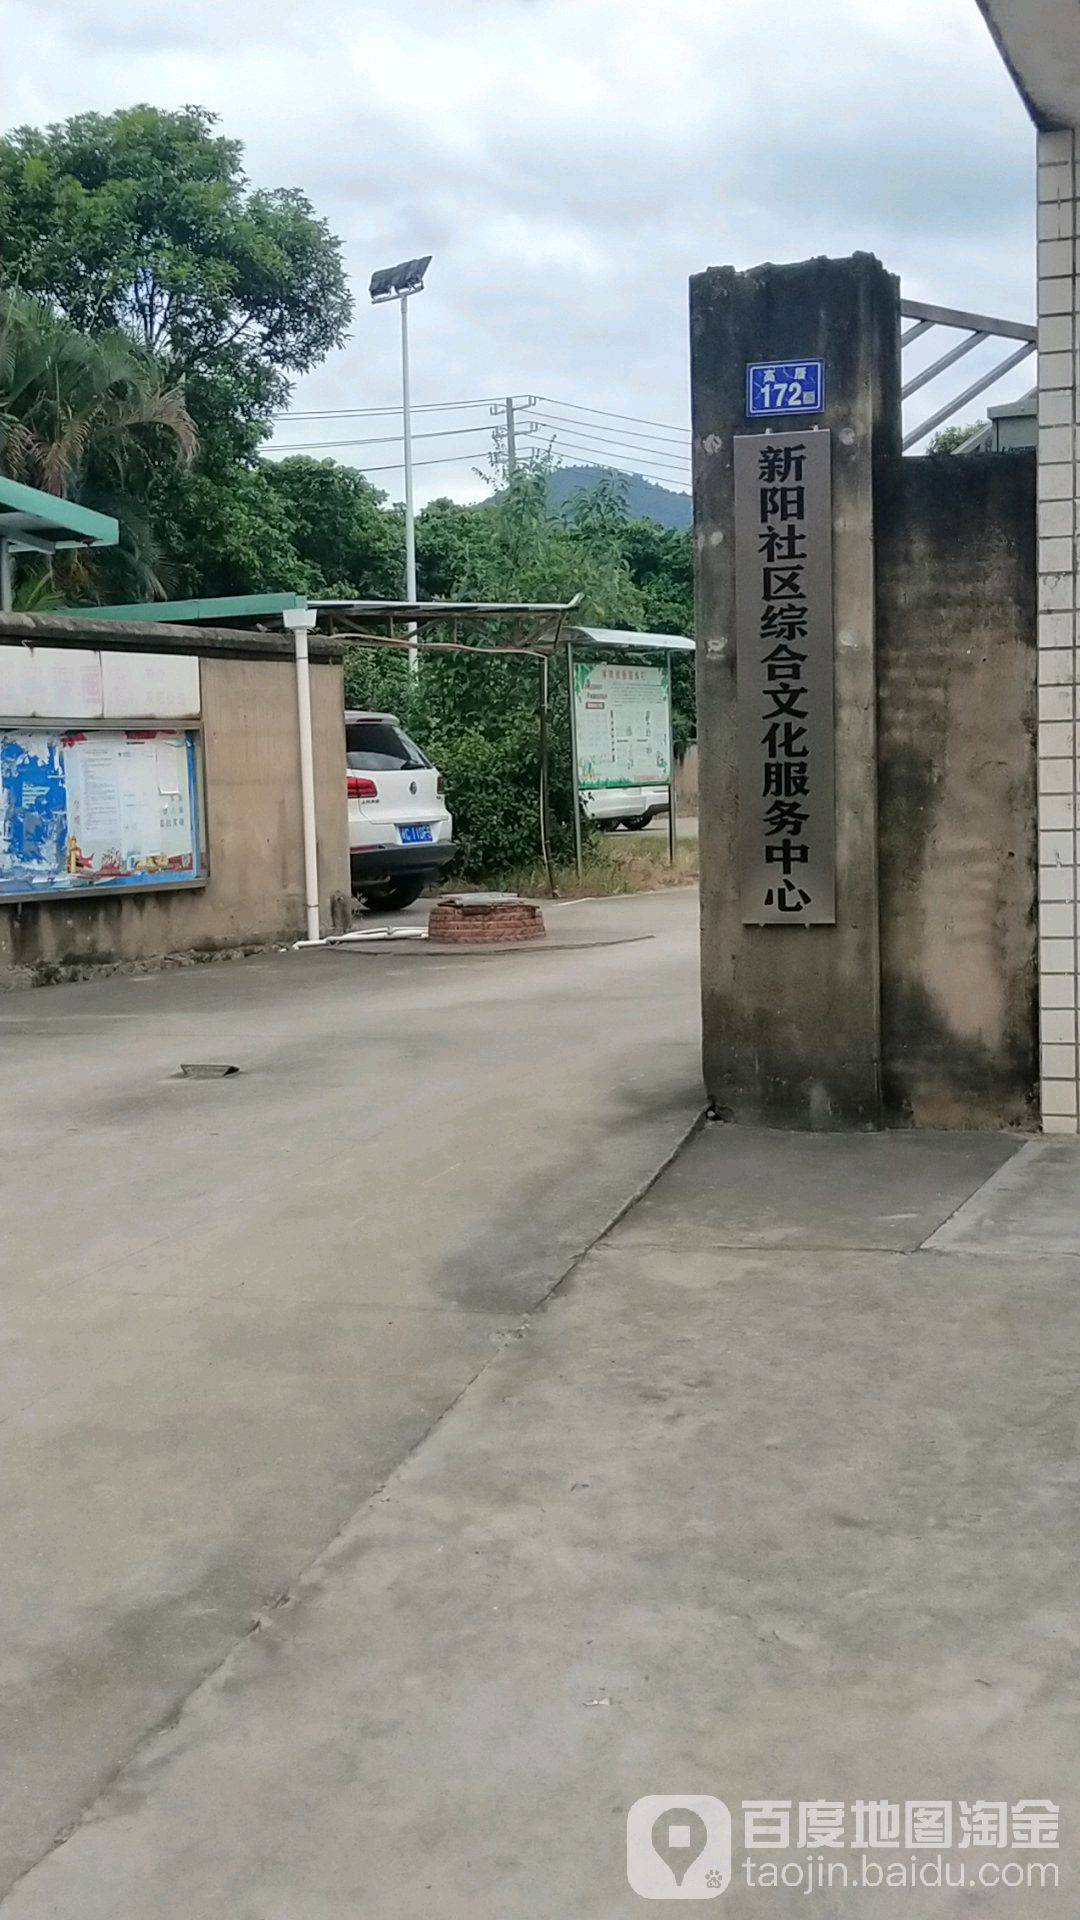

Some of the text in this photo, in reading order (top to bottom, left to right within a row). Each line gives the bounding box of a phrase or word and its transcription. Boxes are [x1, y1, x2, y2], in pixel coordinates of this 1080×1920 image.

[761, 382, 802, 407] 172
[758, 444, 812, 915] 新阳社区综合文化服务中心
